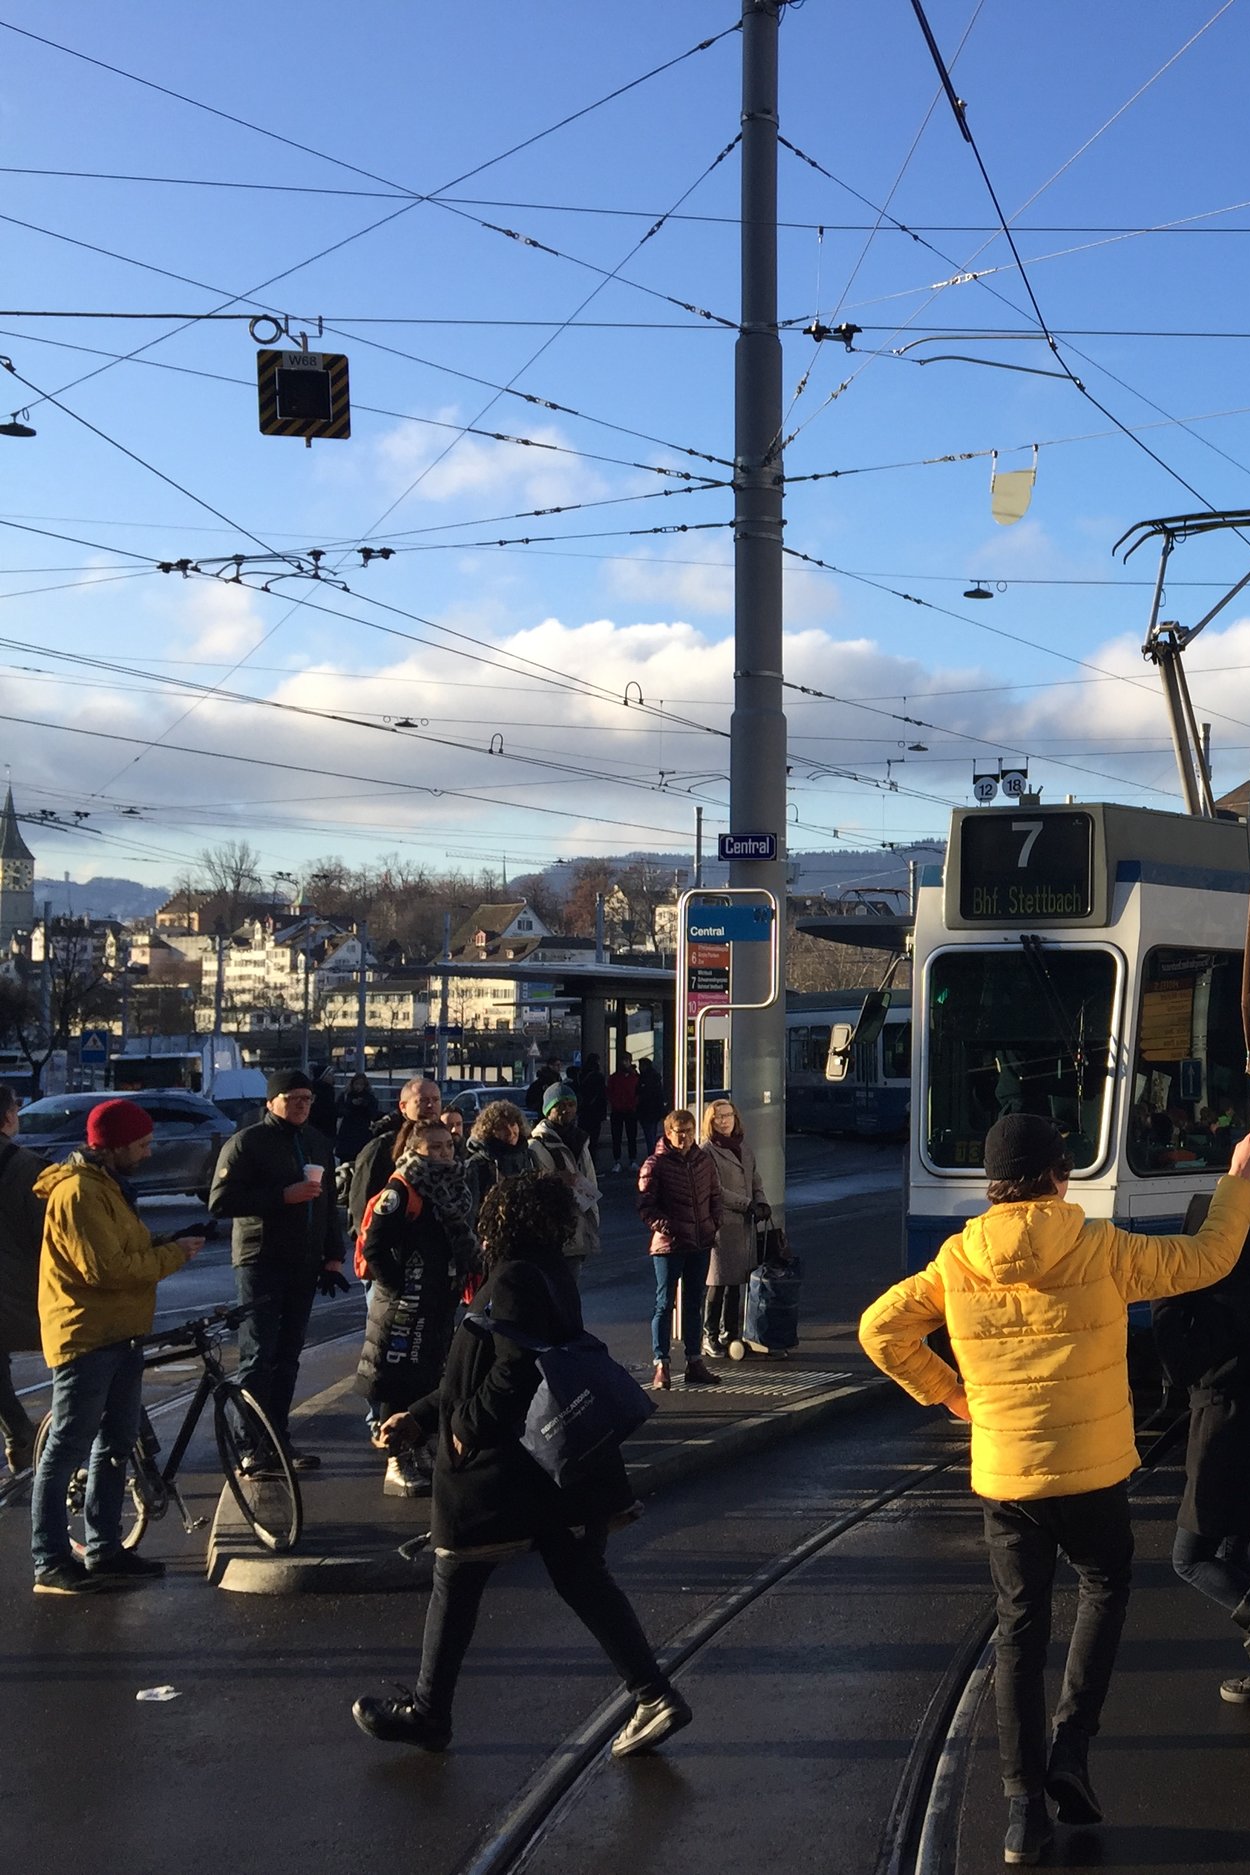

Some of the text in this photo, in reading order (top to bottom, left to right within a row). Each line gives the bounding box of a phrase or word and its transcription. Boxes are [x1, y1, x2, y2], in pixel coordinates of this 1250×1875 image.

[288, 355, 317, 366] W68
[978, 784, 993, 796] 12
[725, 837, 770, 854] Central
[1011, 821, 1044, 868] 7
[1008, 884, 1082, 914] Stettbach
[690, 926, 725, 937] Central
[691, 952, 697, 964] 6
[691, 976, 697, 989] 7
[688, 1001, 697, 1013] 10
